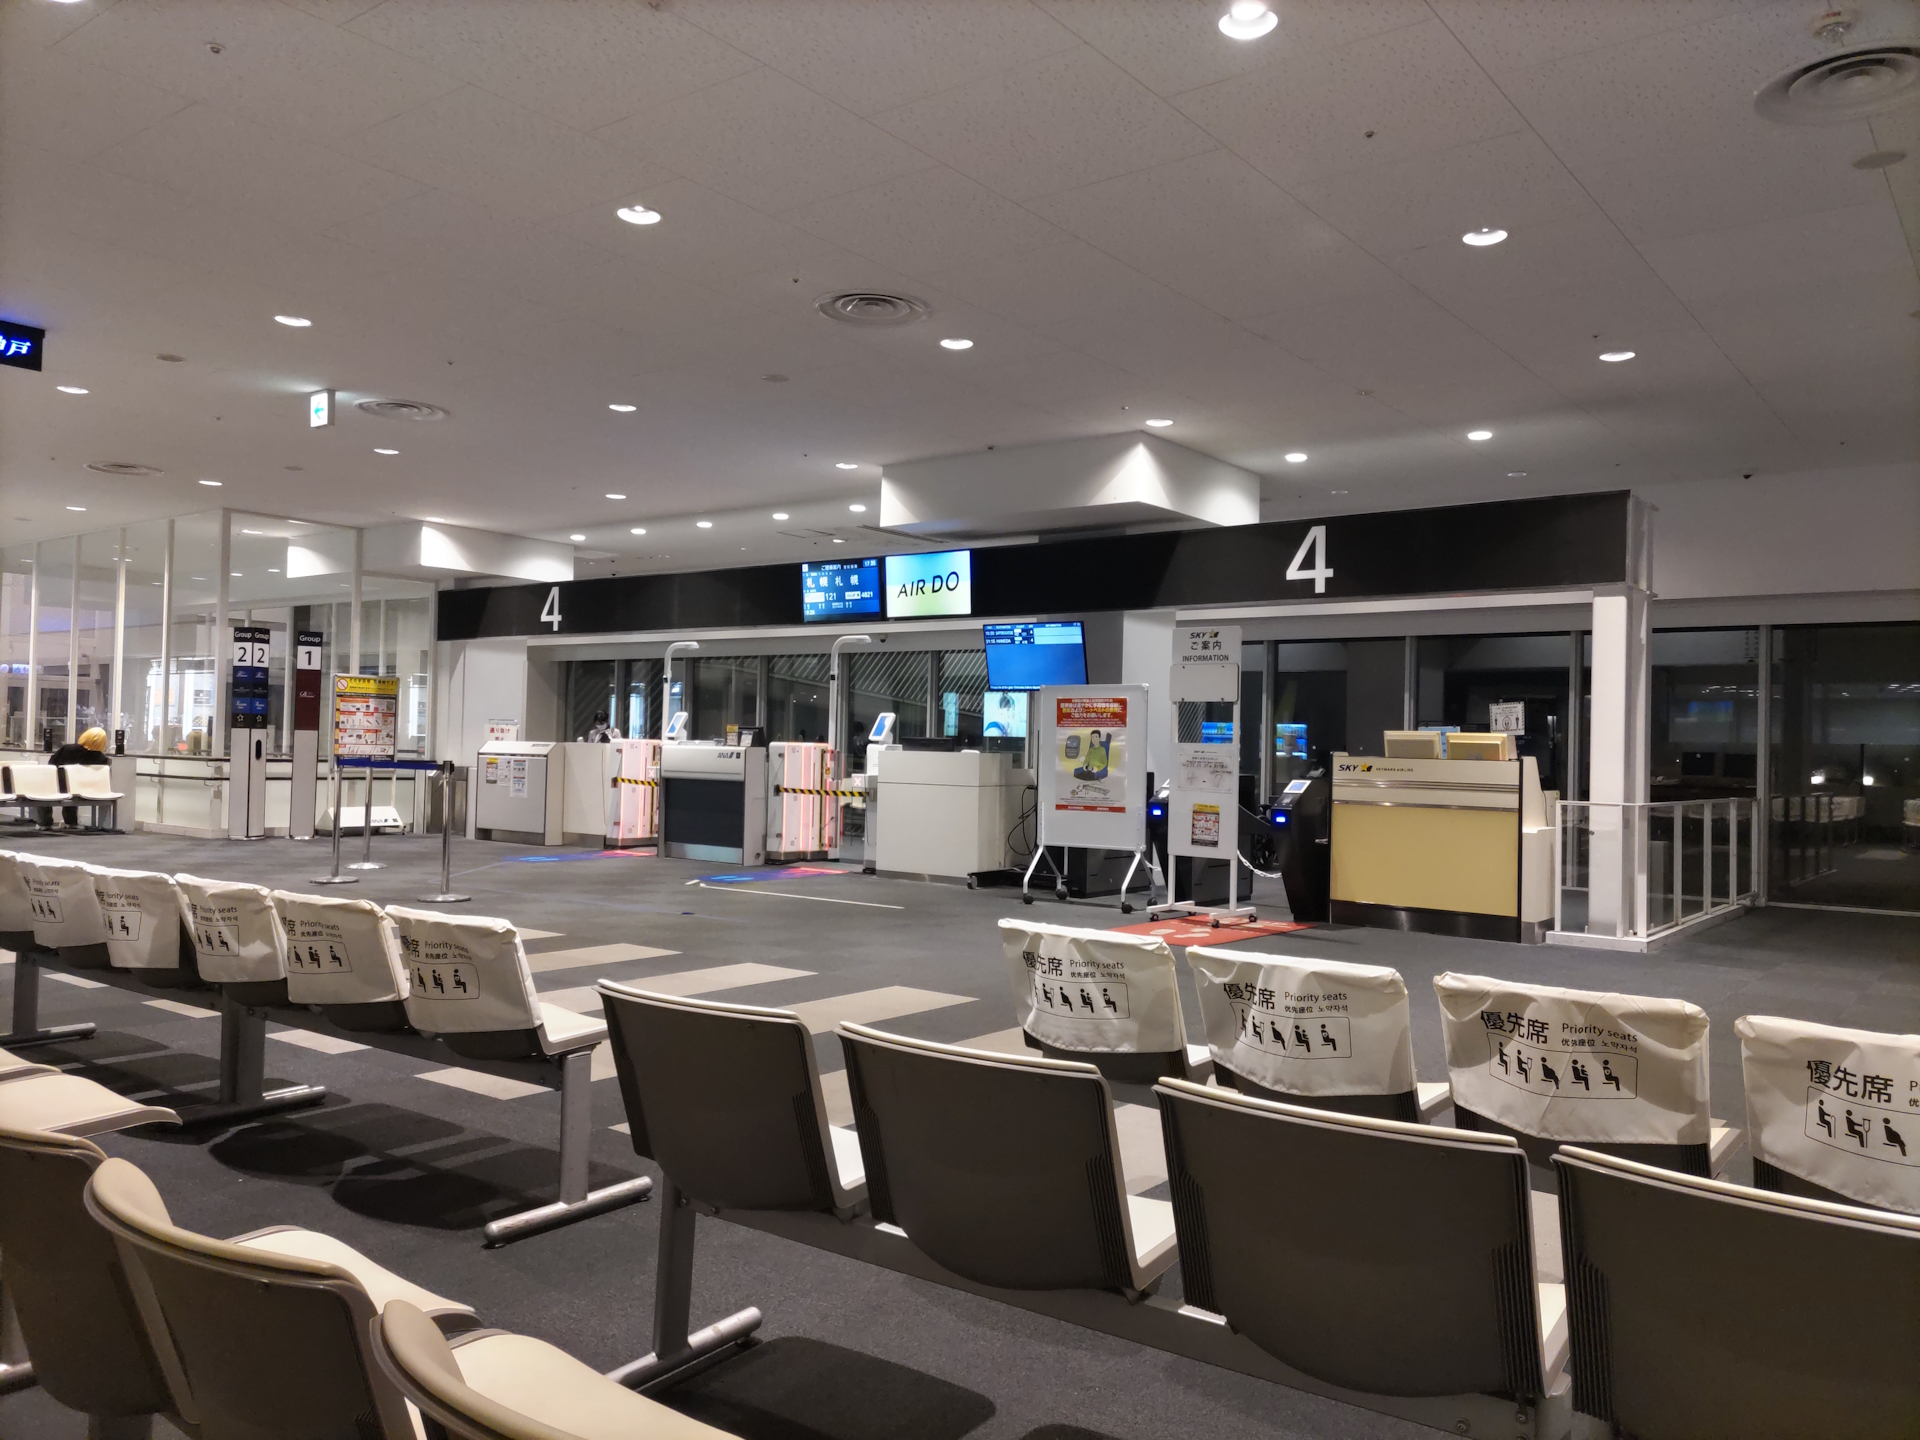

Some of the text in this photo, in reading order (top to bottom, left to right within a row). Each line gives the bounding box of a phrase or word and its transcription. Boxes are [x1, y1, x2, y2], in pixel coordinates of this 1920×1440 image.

[1285, 525, 1334, 594] 4
[897, 571, 960, 598] AIR DO
[540, 586, 562, 631] 4
[234, 631, 252, 639] Group
[254, 632, 270, 640] Group
[299, 634, 321, 643] Group
[1189, 631, 1208, 639] SKY
[1190, 640, 1222, 651] ご案内
[237, 646, 247, 662] 2
[256, 647, 265, 663] 2
[304, 650, 312, 666] 1
[1182, 654, 1230, 663] INFORMATION
[1338, 764, 1359, 772] SKY
[217, 906, 238, 914] seats
[1069, 959, 1125, 970] Priority seats
[1223, 982, 1276, 1010] 優先席
[1284, 991, 1348, 1004] Priority seats
[1480, 1010, 1550, 1045] 優先席
[1562, 1022, 1639, 1043] Priority seats
[1806, 1059, 1894, 1104] 優先席
[1909, 1079, 1920, 1092] P
